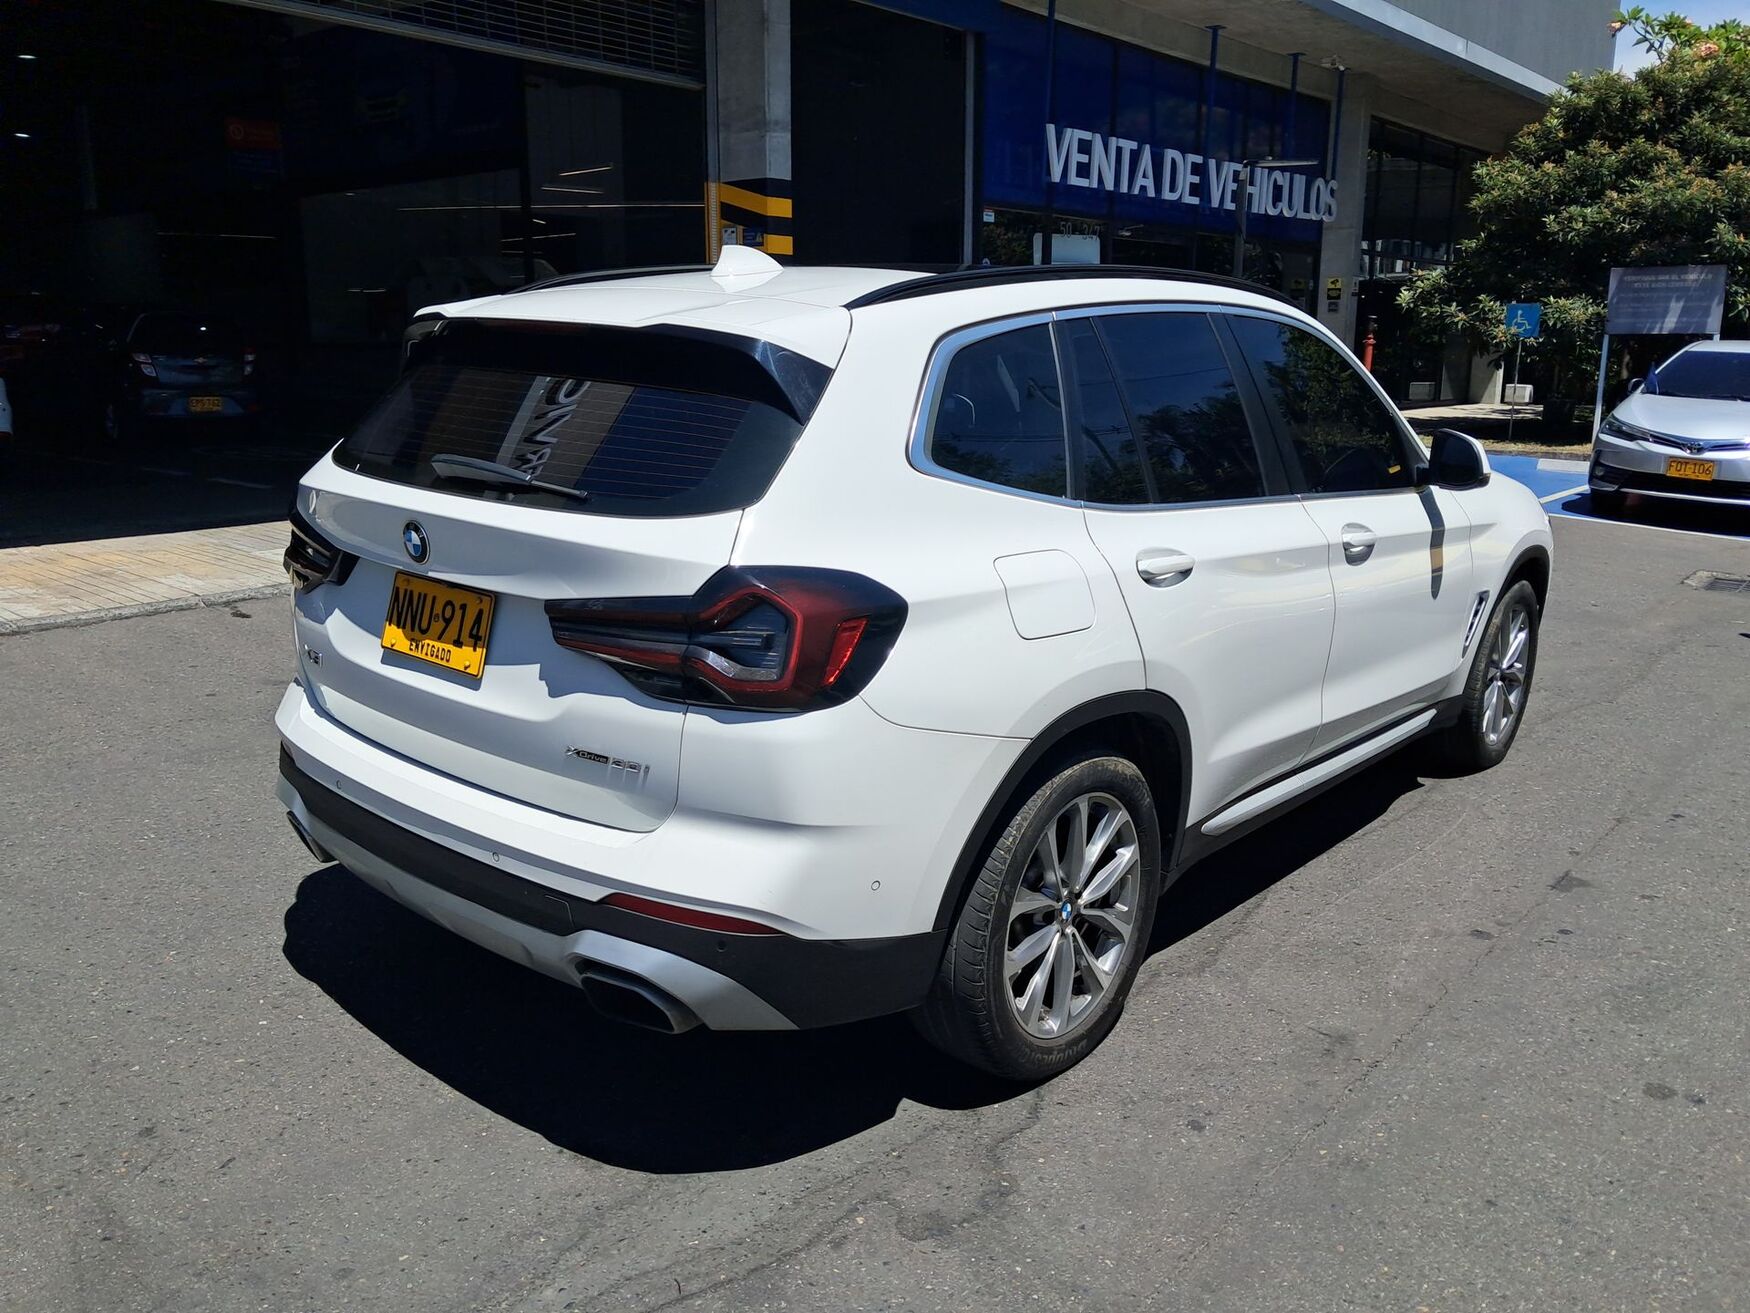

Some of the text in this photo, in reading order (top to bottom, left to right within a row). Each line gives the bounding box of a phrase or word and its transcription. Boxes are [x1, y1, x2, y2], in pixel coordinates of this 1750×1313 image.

[1046, 123, 1339, 222] VENTA DE VEHICULOS
[409, 638, 451, 663] ENVIGADO
